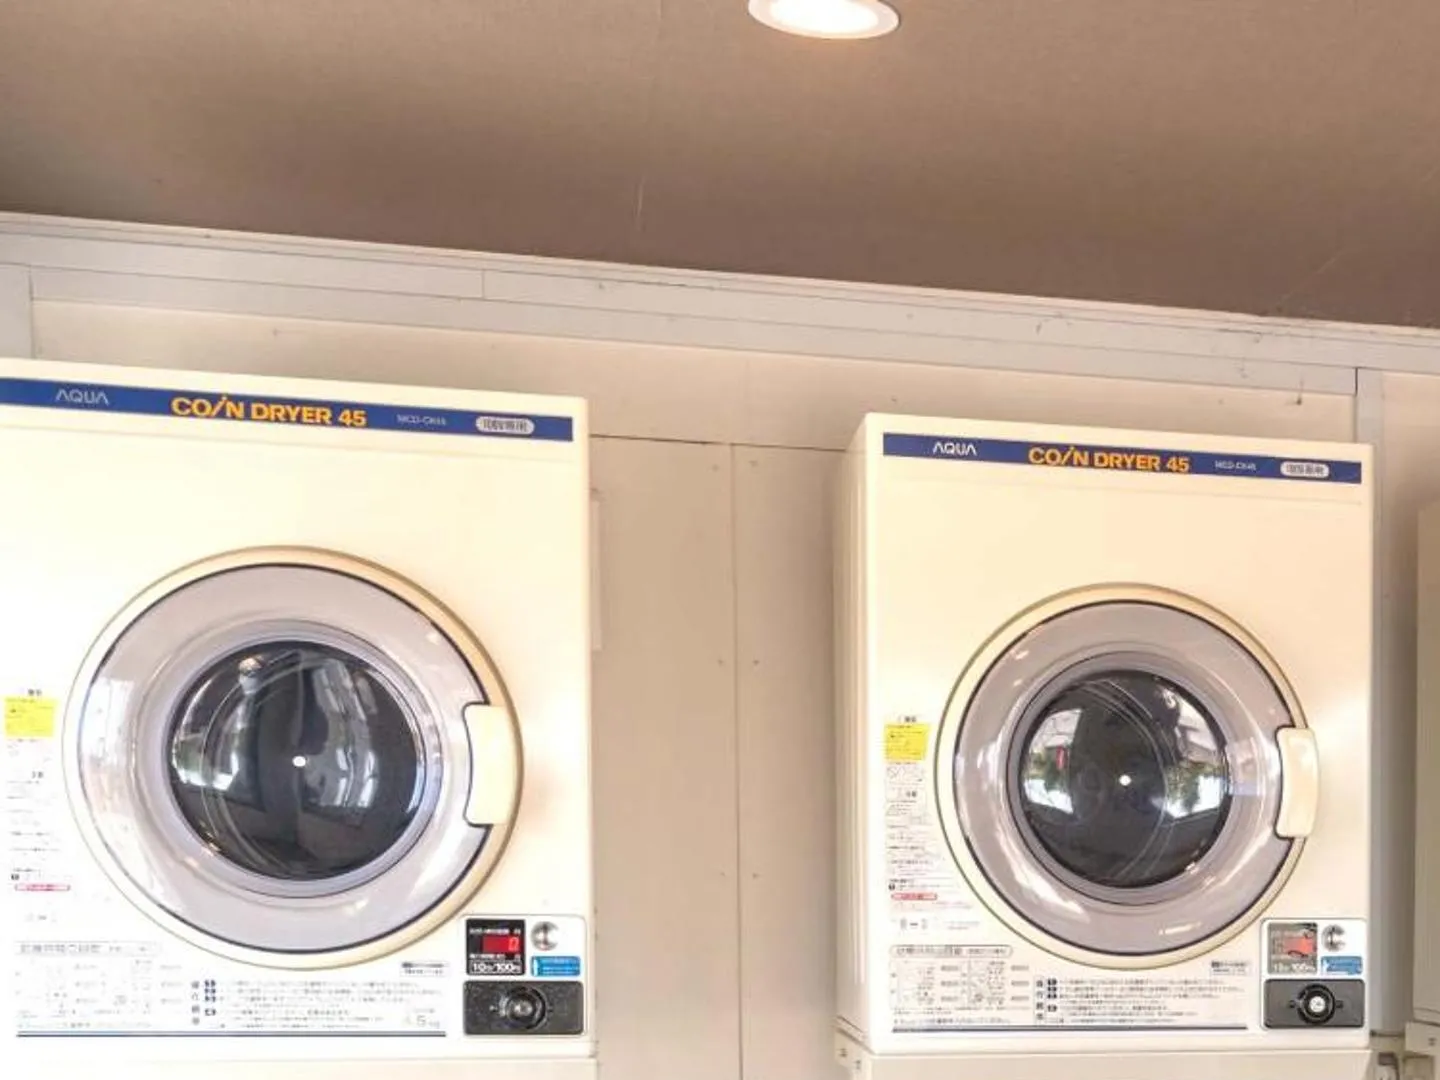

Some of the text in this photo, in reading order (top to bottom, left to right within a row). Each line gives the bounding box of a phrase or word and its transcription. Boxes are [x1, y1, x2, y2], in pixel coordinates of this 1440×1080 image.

[55, 388, 109, 405] AQUA
[250, 402, 332, 426] DRYER
[337, 408, 367, 428] 45
[932, 441, 978, 456] AQUA
[1093, 451, 1161, 471] DRYER
[1166, 456, 1190, 473] 45
